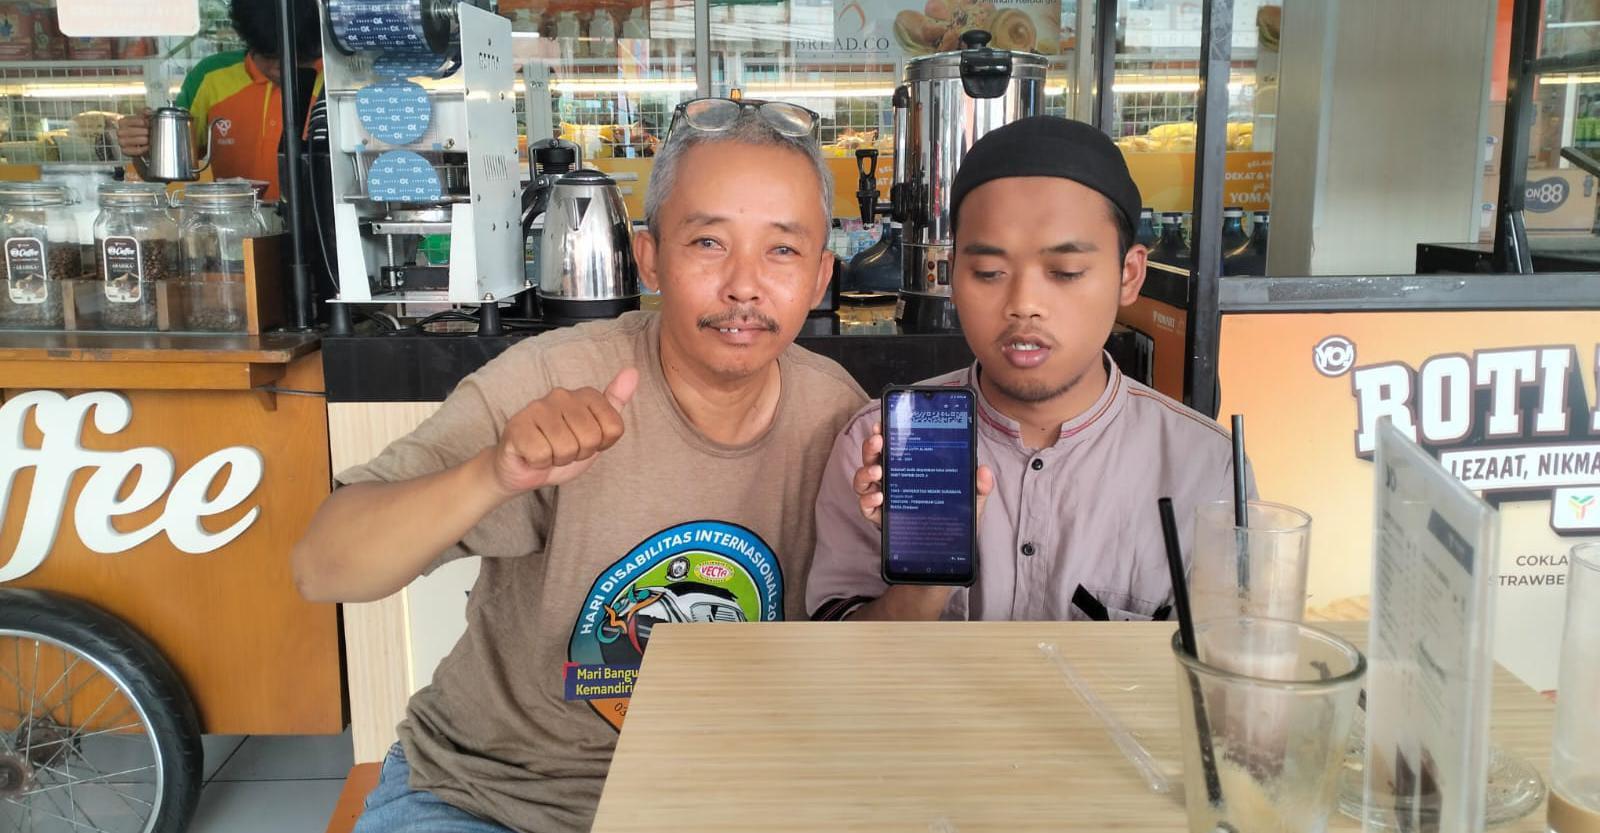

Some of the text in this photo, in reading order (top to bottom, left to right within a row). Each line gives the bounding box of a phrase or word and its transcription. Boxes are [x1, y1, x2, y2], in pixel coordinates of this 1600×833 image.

[1353, 347, 1571, 453] ROTI
[1451, 454, 1528, 481] LEZAAT,
[701, 565, 727, 578] VECTA
[580, 595, 605, 635] HARI
[600, 531, 691, 593] DISABILITAS
[695, 529, 778, 602] INTERNASIONAL
[577, 667, 602, 680] Mari
[576, 682, 633, 695] Kemandiri
